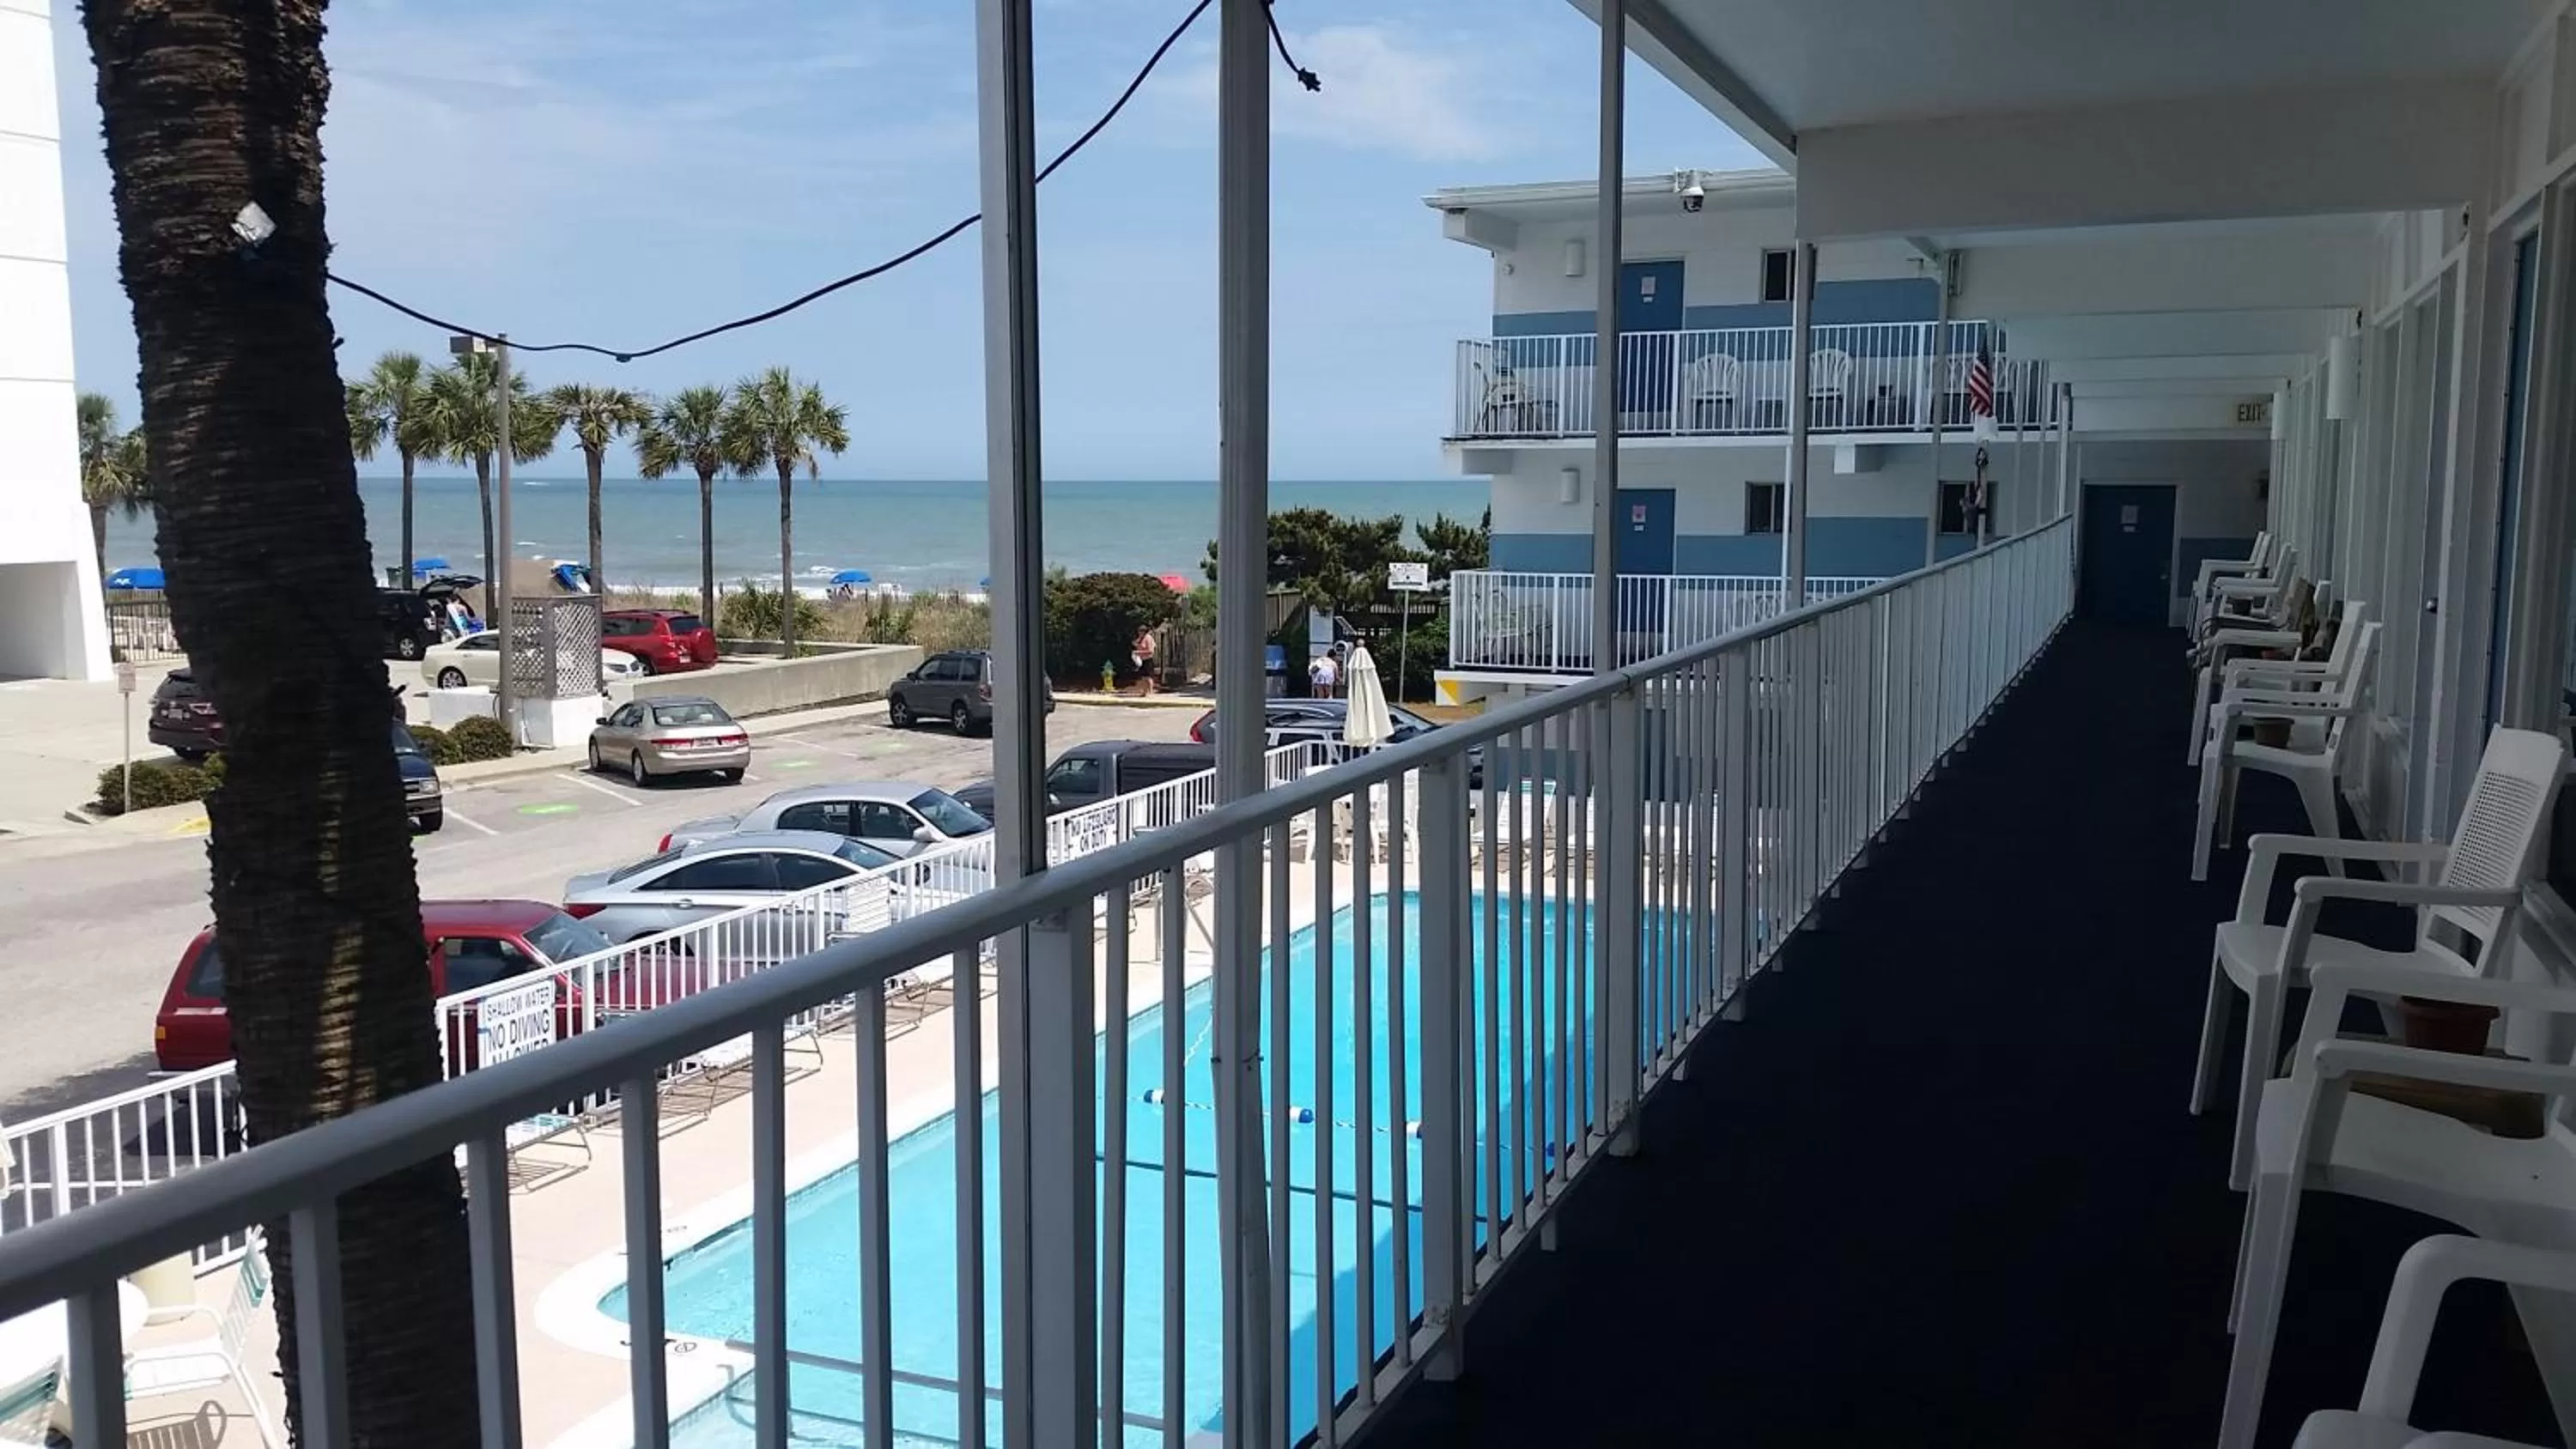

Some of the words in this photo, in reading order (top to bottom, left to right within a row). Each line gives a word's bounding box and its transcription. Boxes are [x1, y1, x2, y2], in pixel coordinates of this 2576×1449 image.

[2238, 403, 2262, 422] EXIT
[487, 995, 523, 1022] SHALLOW
[525, 986, 550, 1009] WATER
[489, 1023, 506, 1052] NO
[509, 1009, 550, 1045] DIVING
